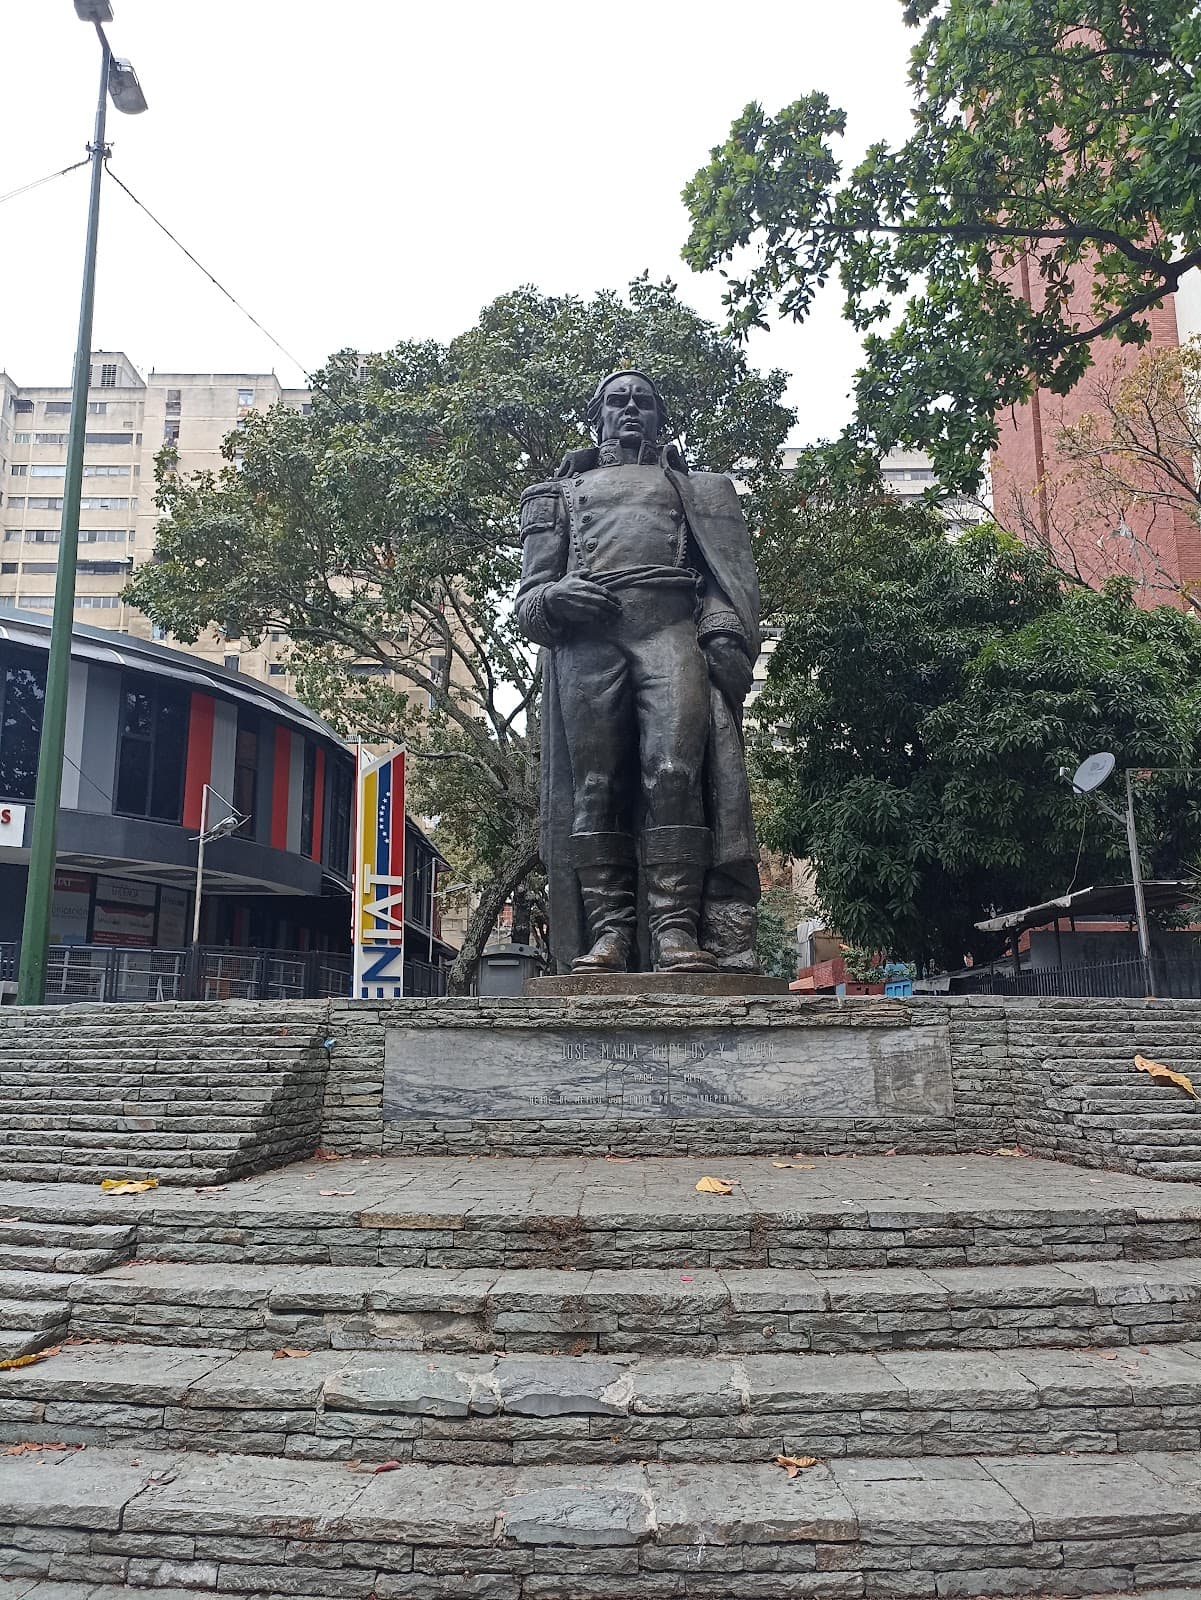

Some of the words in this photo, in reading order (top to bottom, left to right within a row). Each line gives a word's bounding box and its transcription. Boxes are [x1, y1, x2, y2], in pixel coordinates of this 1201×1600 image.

[560, 1043, 588, 1060] JOSE
[600, 1042, 638, 1060] MARIA
[718, 1042, 725, 1058] Y
